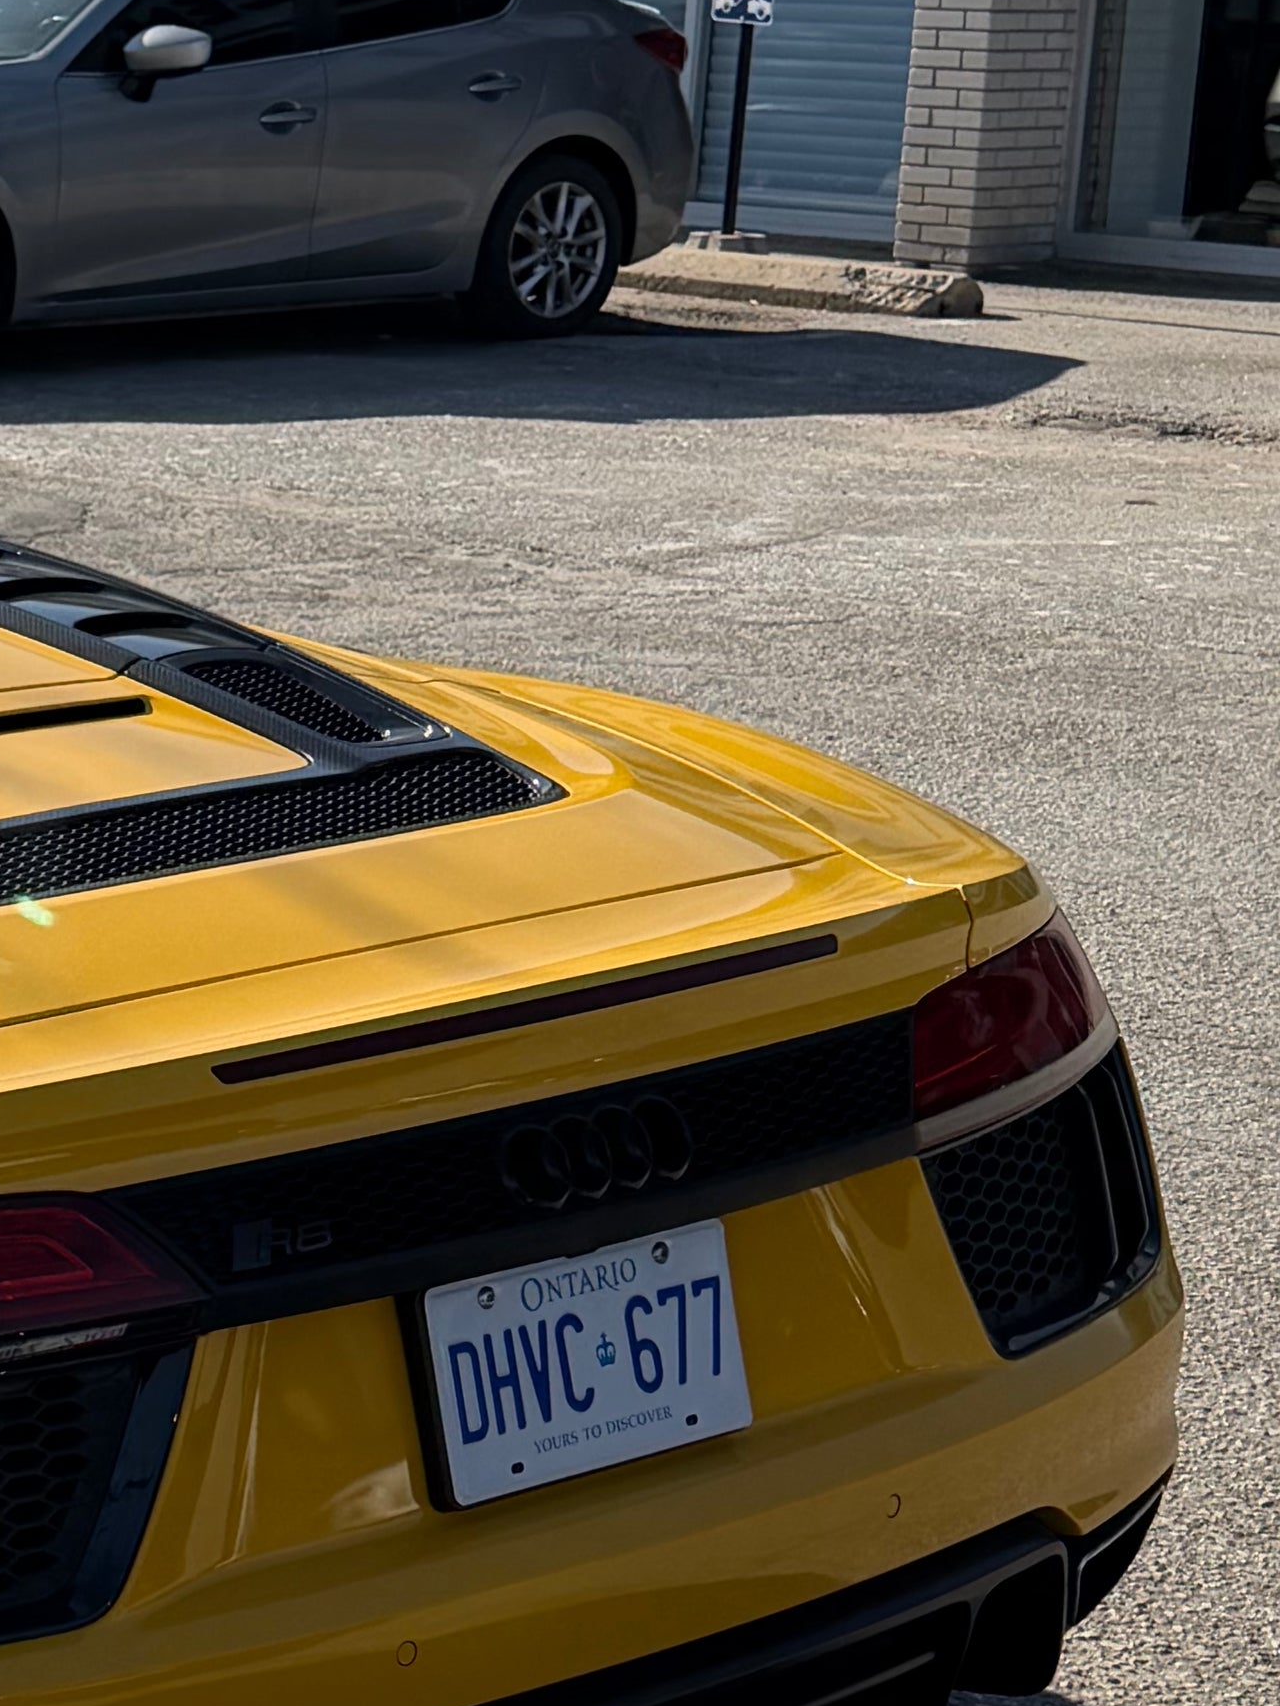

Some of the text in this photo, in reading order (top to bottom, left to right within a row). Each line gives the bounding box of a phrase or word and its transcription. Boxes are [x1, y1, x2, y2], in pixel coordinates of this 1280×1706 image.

[520, 1257, 637, 1312] ONTARIO
[448, 1275, 721, 1445] DHVC 677
[534, 1405, 673, 1455] YOURS TO DISCOVER
